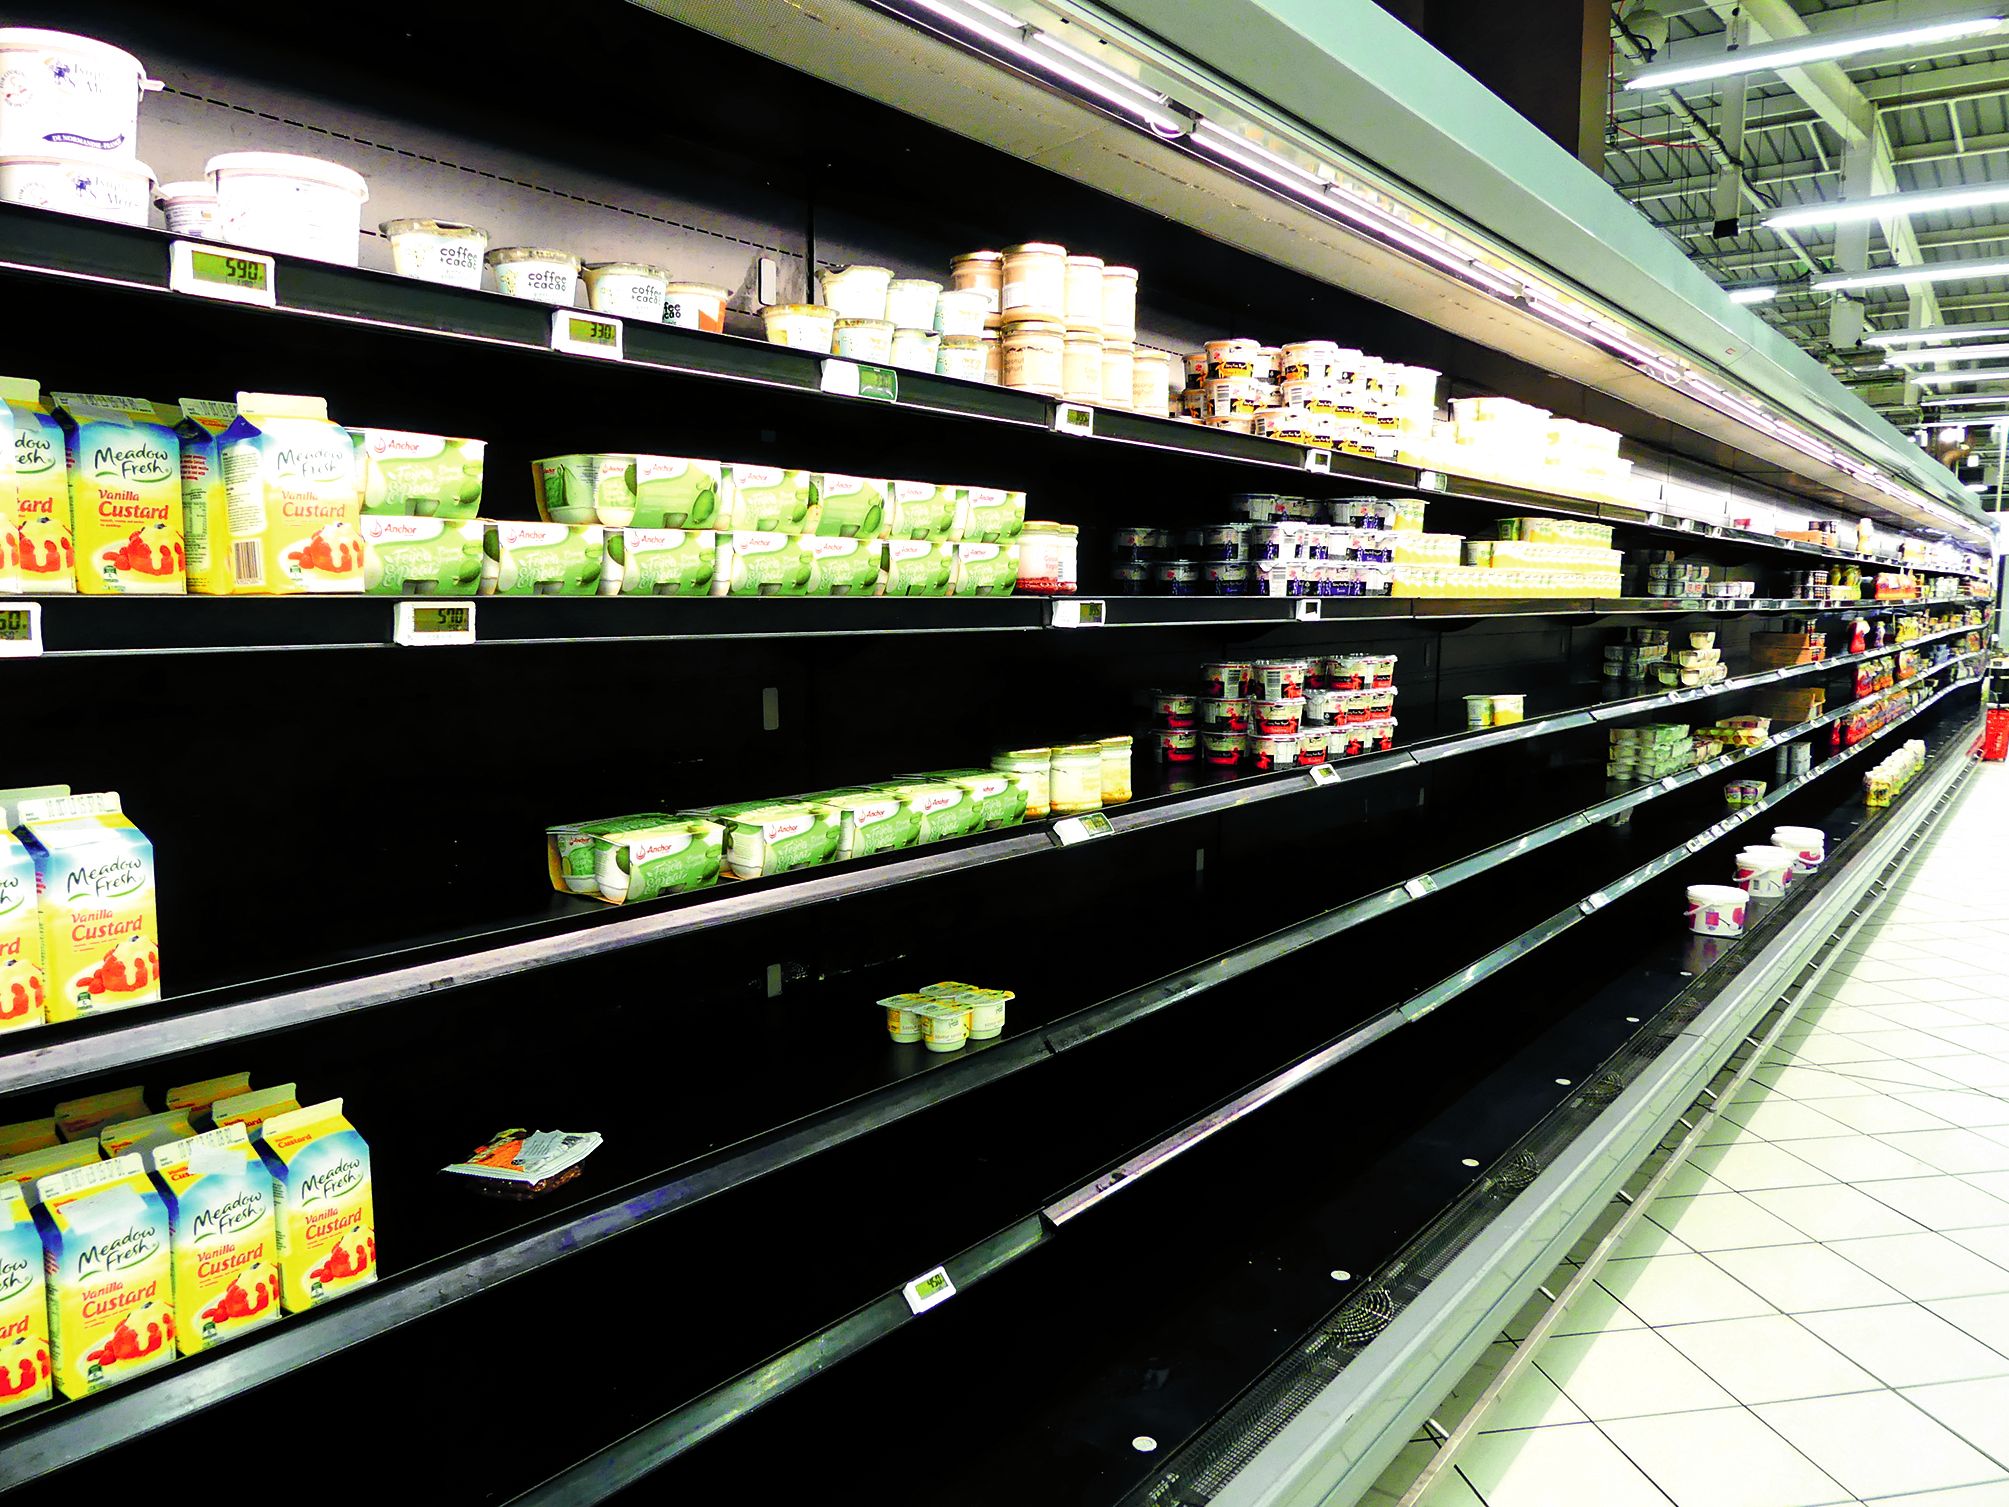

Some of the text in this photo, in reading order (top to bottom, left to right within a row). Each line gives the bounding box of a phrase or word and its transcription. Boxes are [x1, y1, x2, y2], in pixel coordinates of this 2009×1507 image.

[440, 246, 477, 259] coffee
[528, 270, 566, 284] coffee
[15, 432, 50, 450] dow
[388, 440, 419, 451] Anchor
[18, 449, 46, 464] esh
[95, 442, 168, 469] Meadow
[277, 449, 343, 470] Meadow
[122, 459, 164, 479] Fresh
[302, 460, 337, 477] Fresh
[98, 490, 139, 501] Vanilla
[281, 490, 318, 501] Vanilla
[99, 501, 169, 520] Custard
[282, 501, 345, 517] Custard
[384, 523, 416, 534] Anchor
[519, 530, 546, 539] Anchor
[641, 535, 665, 543] Anchor
[777, 825, 798, 833] Anchor
[646, 844, 672, 855] Anchor
[67, 856, 143, 893] Meadow
[96, 875, 136, 896] Fresh
[71, 909, 113, 923] Vanilla
[71, 915, 143, 942] Custard
[278, 1133, 312, 1148] Custard
[302, 1157, 360, 1200] Meadow
[324, 1170, 356, 1199] Fresh
[193, 1191, 262, 1236] Meadow
[219, 1204, 258, 1235] Fresh
[305, 1208, 338, 1225] Vanilla
[306, 1207, 362, 1240] Custard
[79, 1225, 156, 1273] Meadow
[106, 1239, 149, 1272] Fresh
[197, 1244, 235, 1262] Vanilla
[198, 1243, 263, 1278] Custard
[82, 1281, 123, 1301] Vanilla
[83, 1280, 156, 1318] Custard
